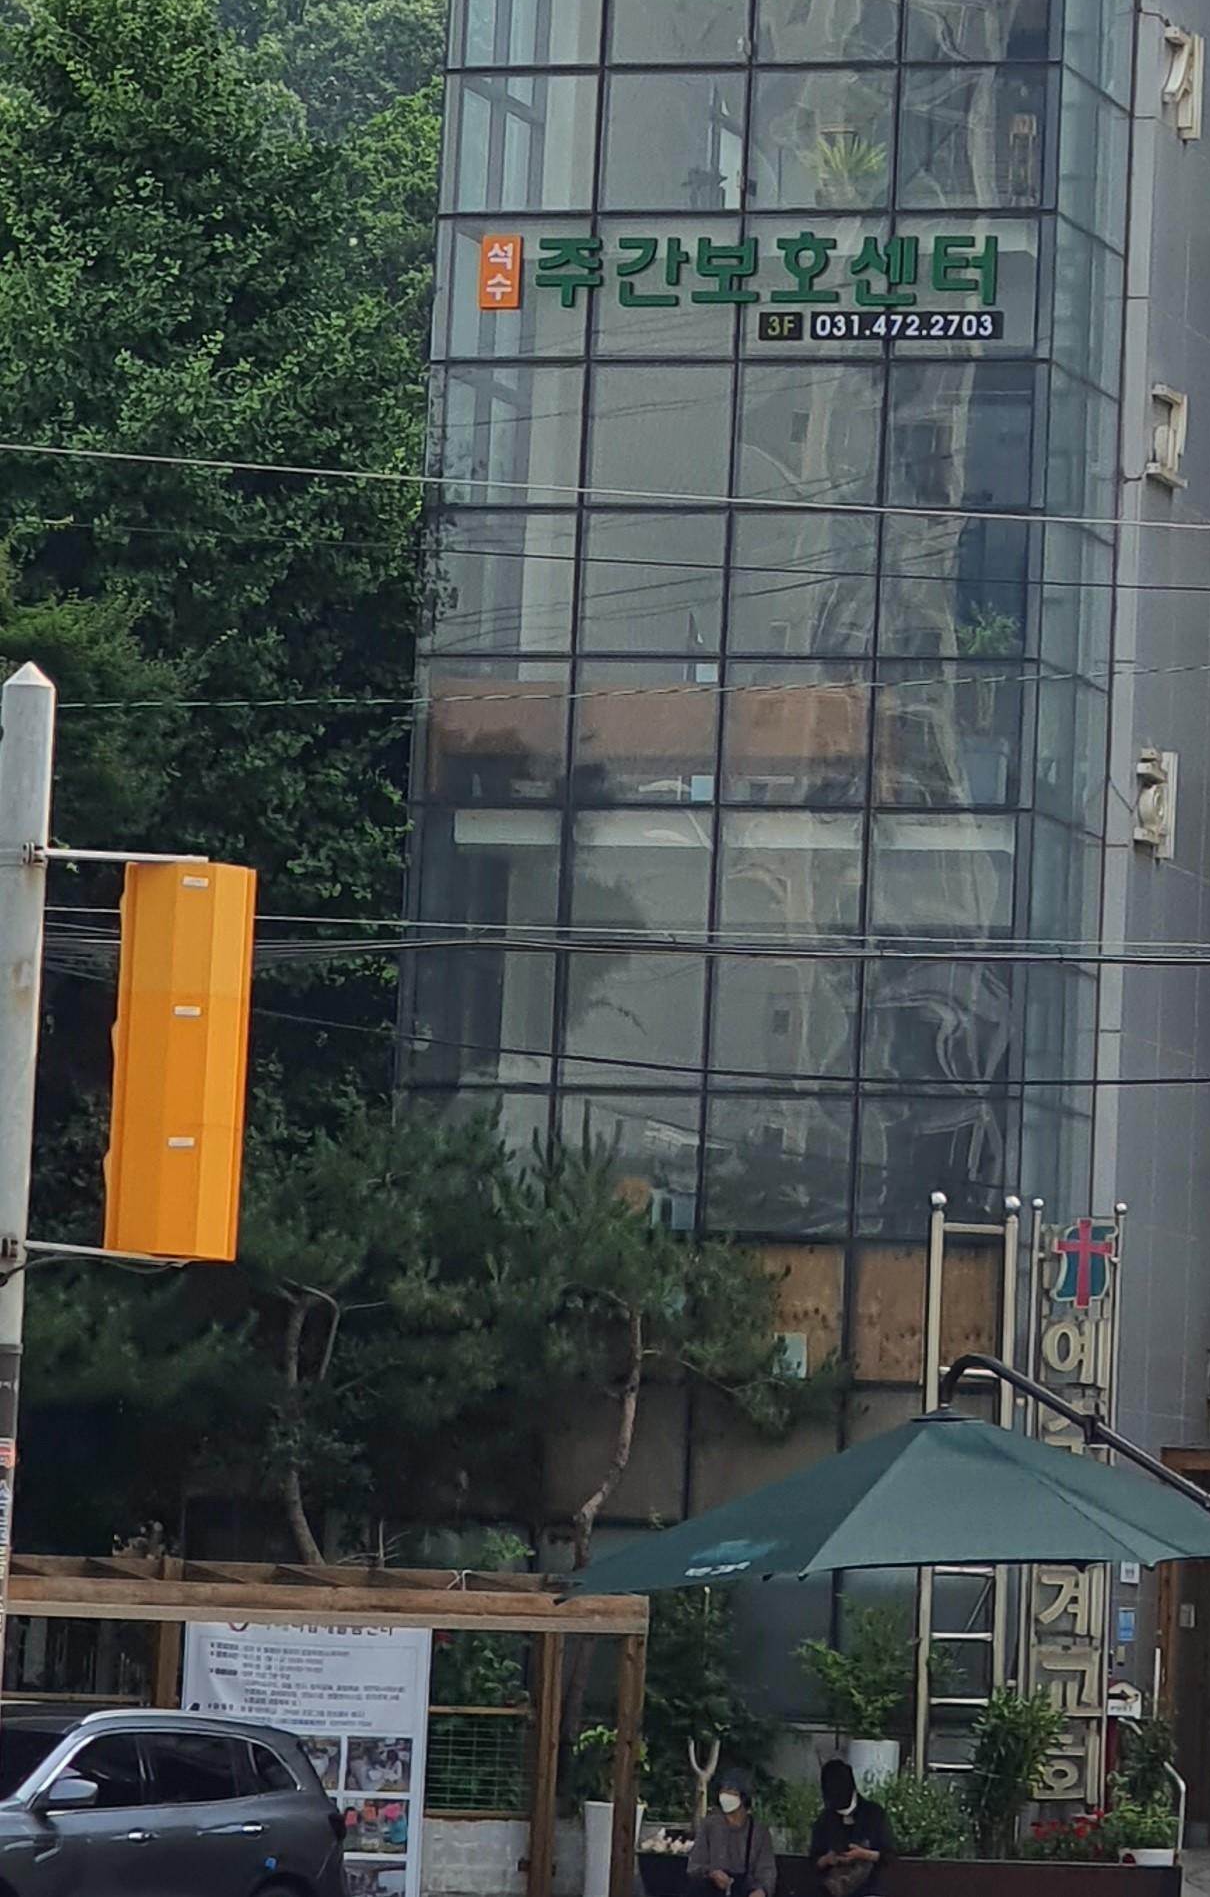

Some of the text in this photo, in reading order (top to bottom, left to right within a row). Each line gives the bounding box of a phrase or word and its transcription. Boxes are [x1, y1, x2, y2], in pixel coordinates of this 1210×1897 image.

[486, 231, 998, 308] 석수 주간보호센터
[767, 314, 994, 338] 3F 031.472.2703
